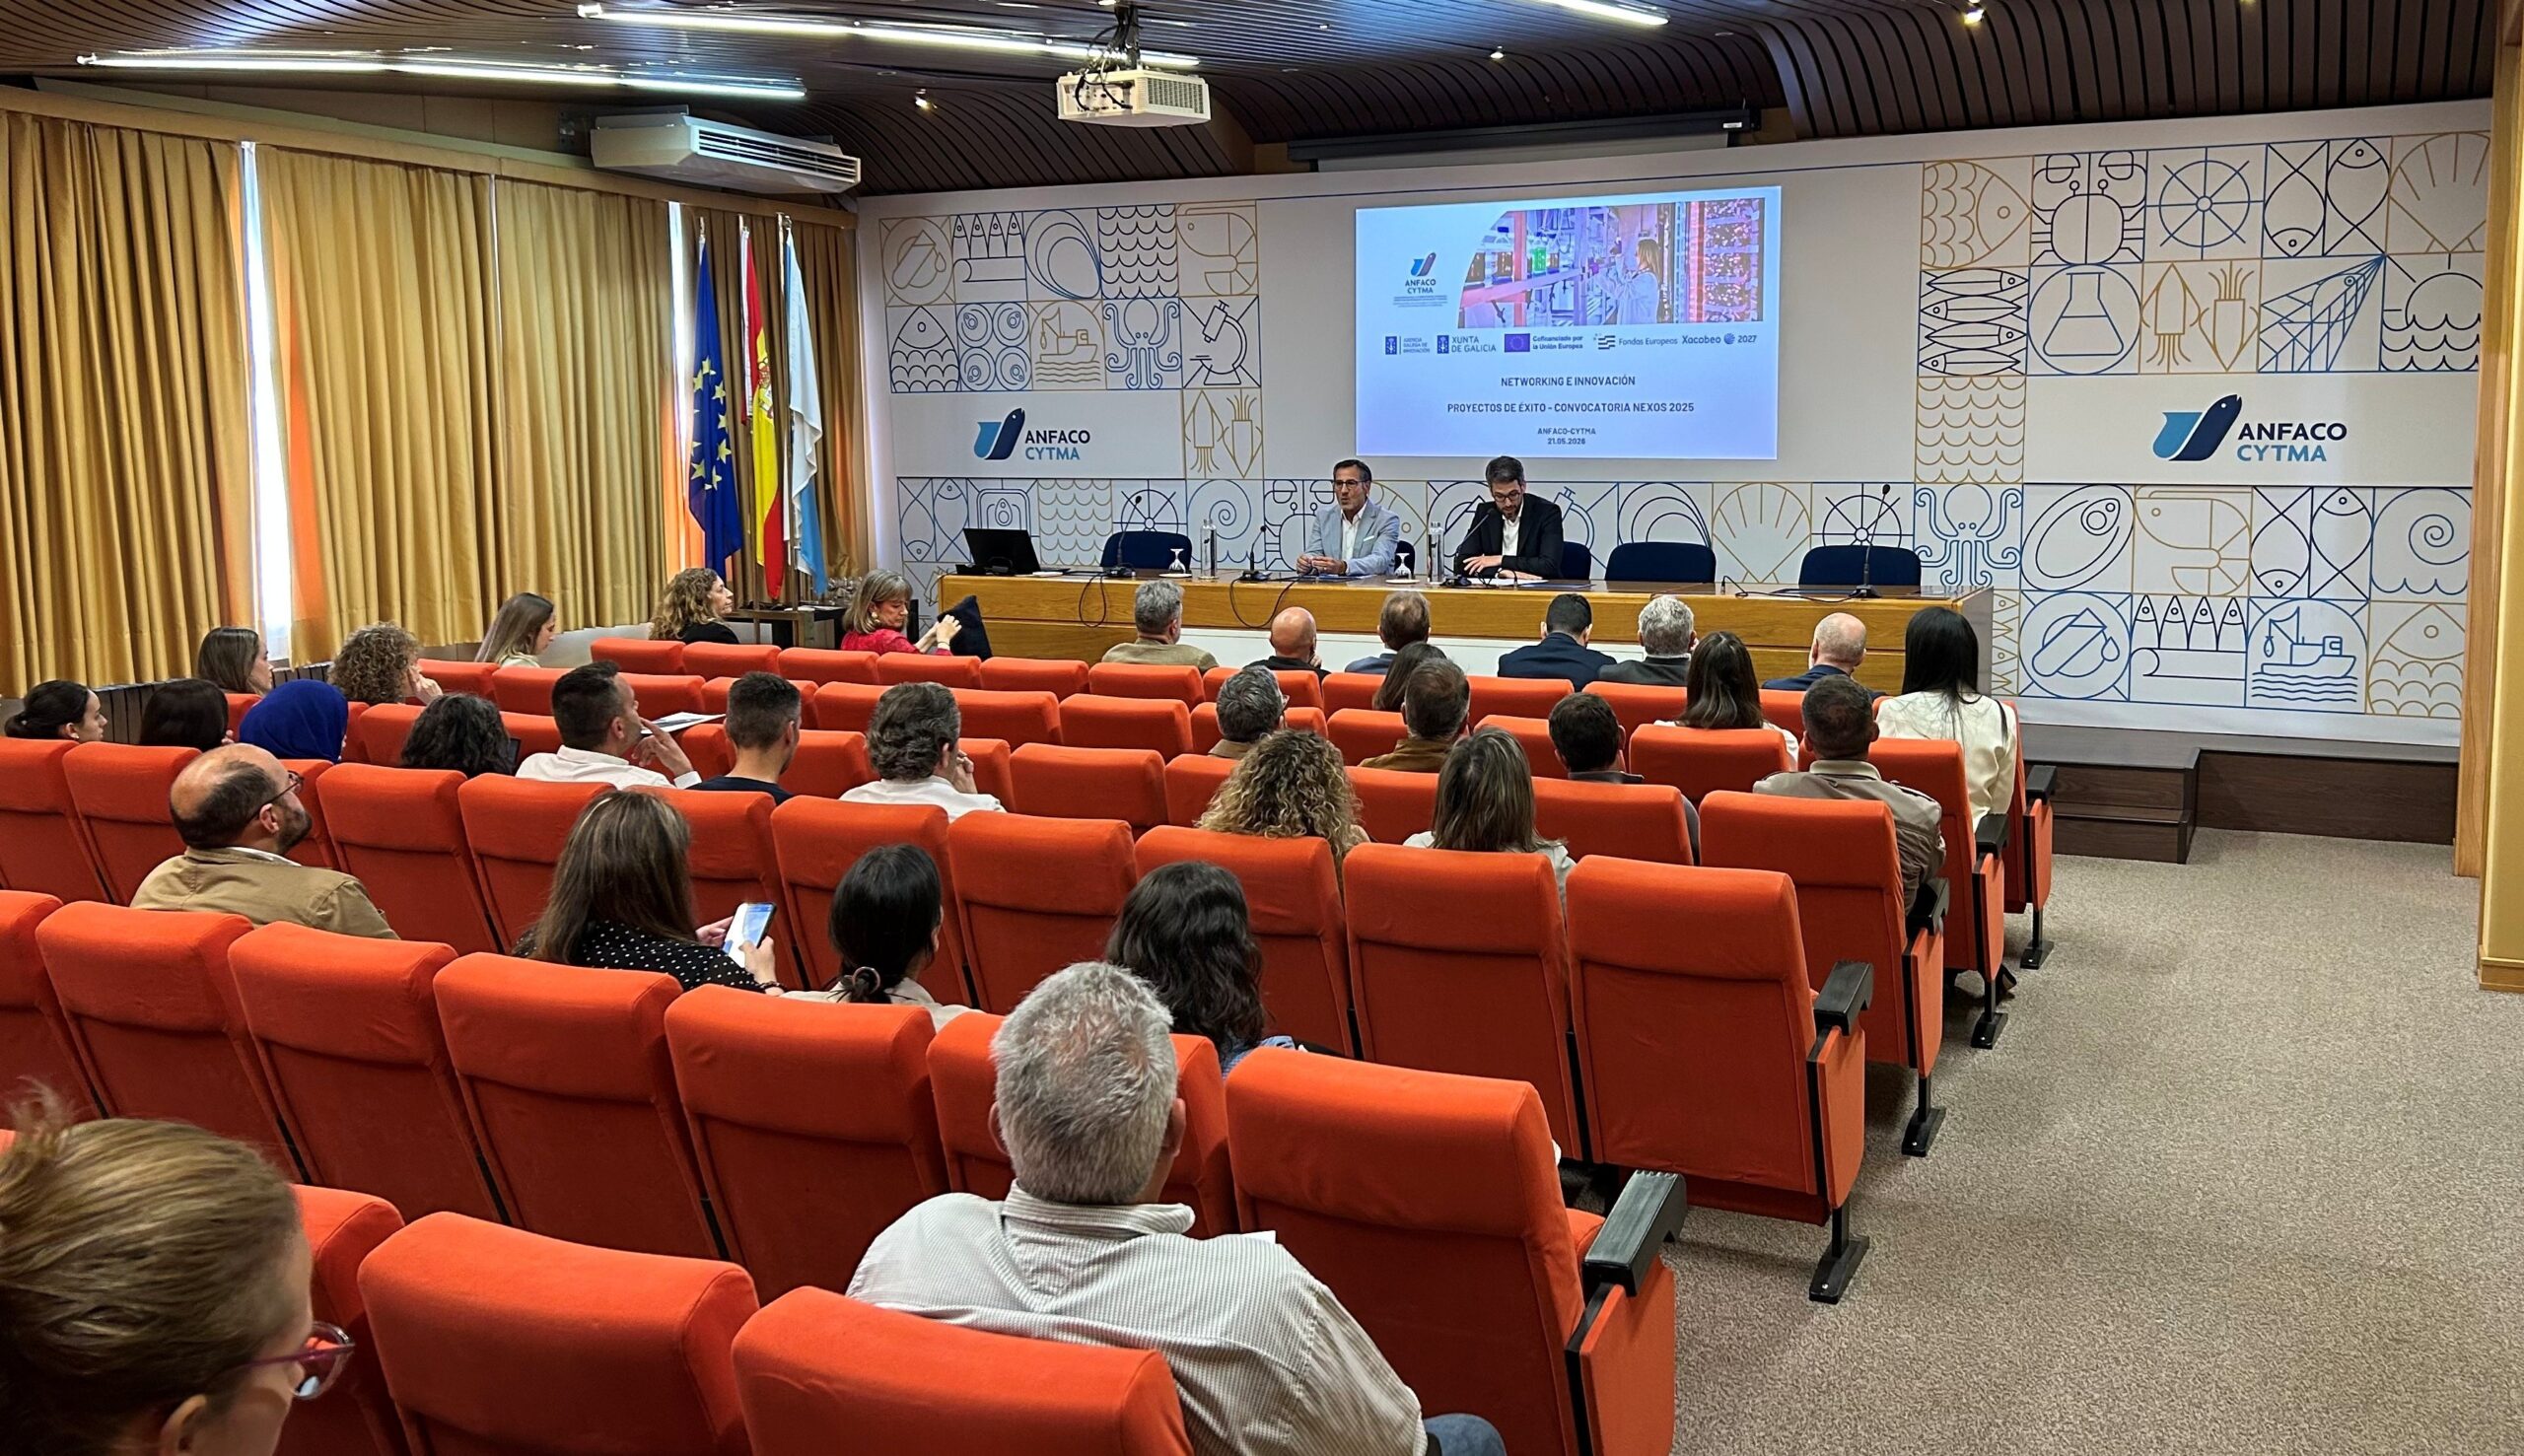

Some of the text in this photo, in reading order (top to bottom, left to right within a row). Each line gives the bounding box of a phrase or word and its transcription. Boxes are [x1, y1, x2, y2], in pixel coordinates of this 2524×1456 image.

[1682, 335, 1757, 345] Xacobeo 2027
[1464, 344, 1497, 353] GALICIA
[1501, 374, 1636, 386] NETWORKING E INNOVACIÓN
[1447, 403, 1503, 413] PROYECTOS
[1504, 403, 1516, 412] DE
[1518, 401, 1546, 412] ÉXITO
[1554, 402, 1631, 412] CONVOCATORIA
[1633, 402, 1667, 412] NEXOS
[1669, 402, 1695, 412] 2025
[1024, 430, 1090, 444] ANFACO
[2237, 422, 2348, 441] ANFACO
[1025, 447, 1081, 460] CYTMA
[2236, 444, 2328, 461] CYTMA
